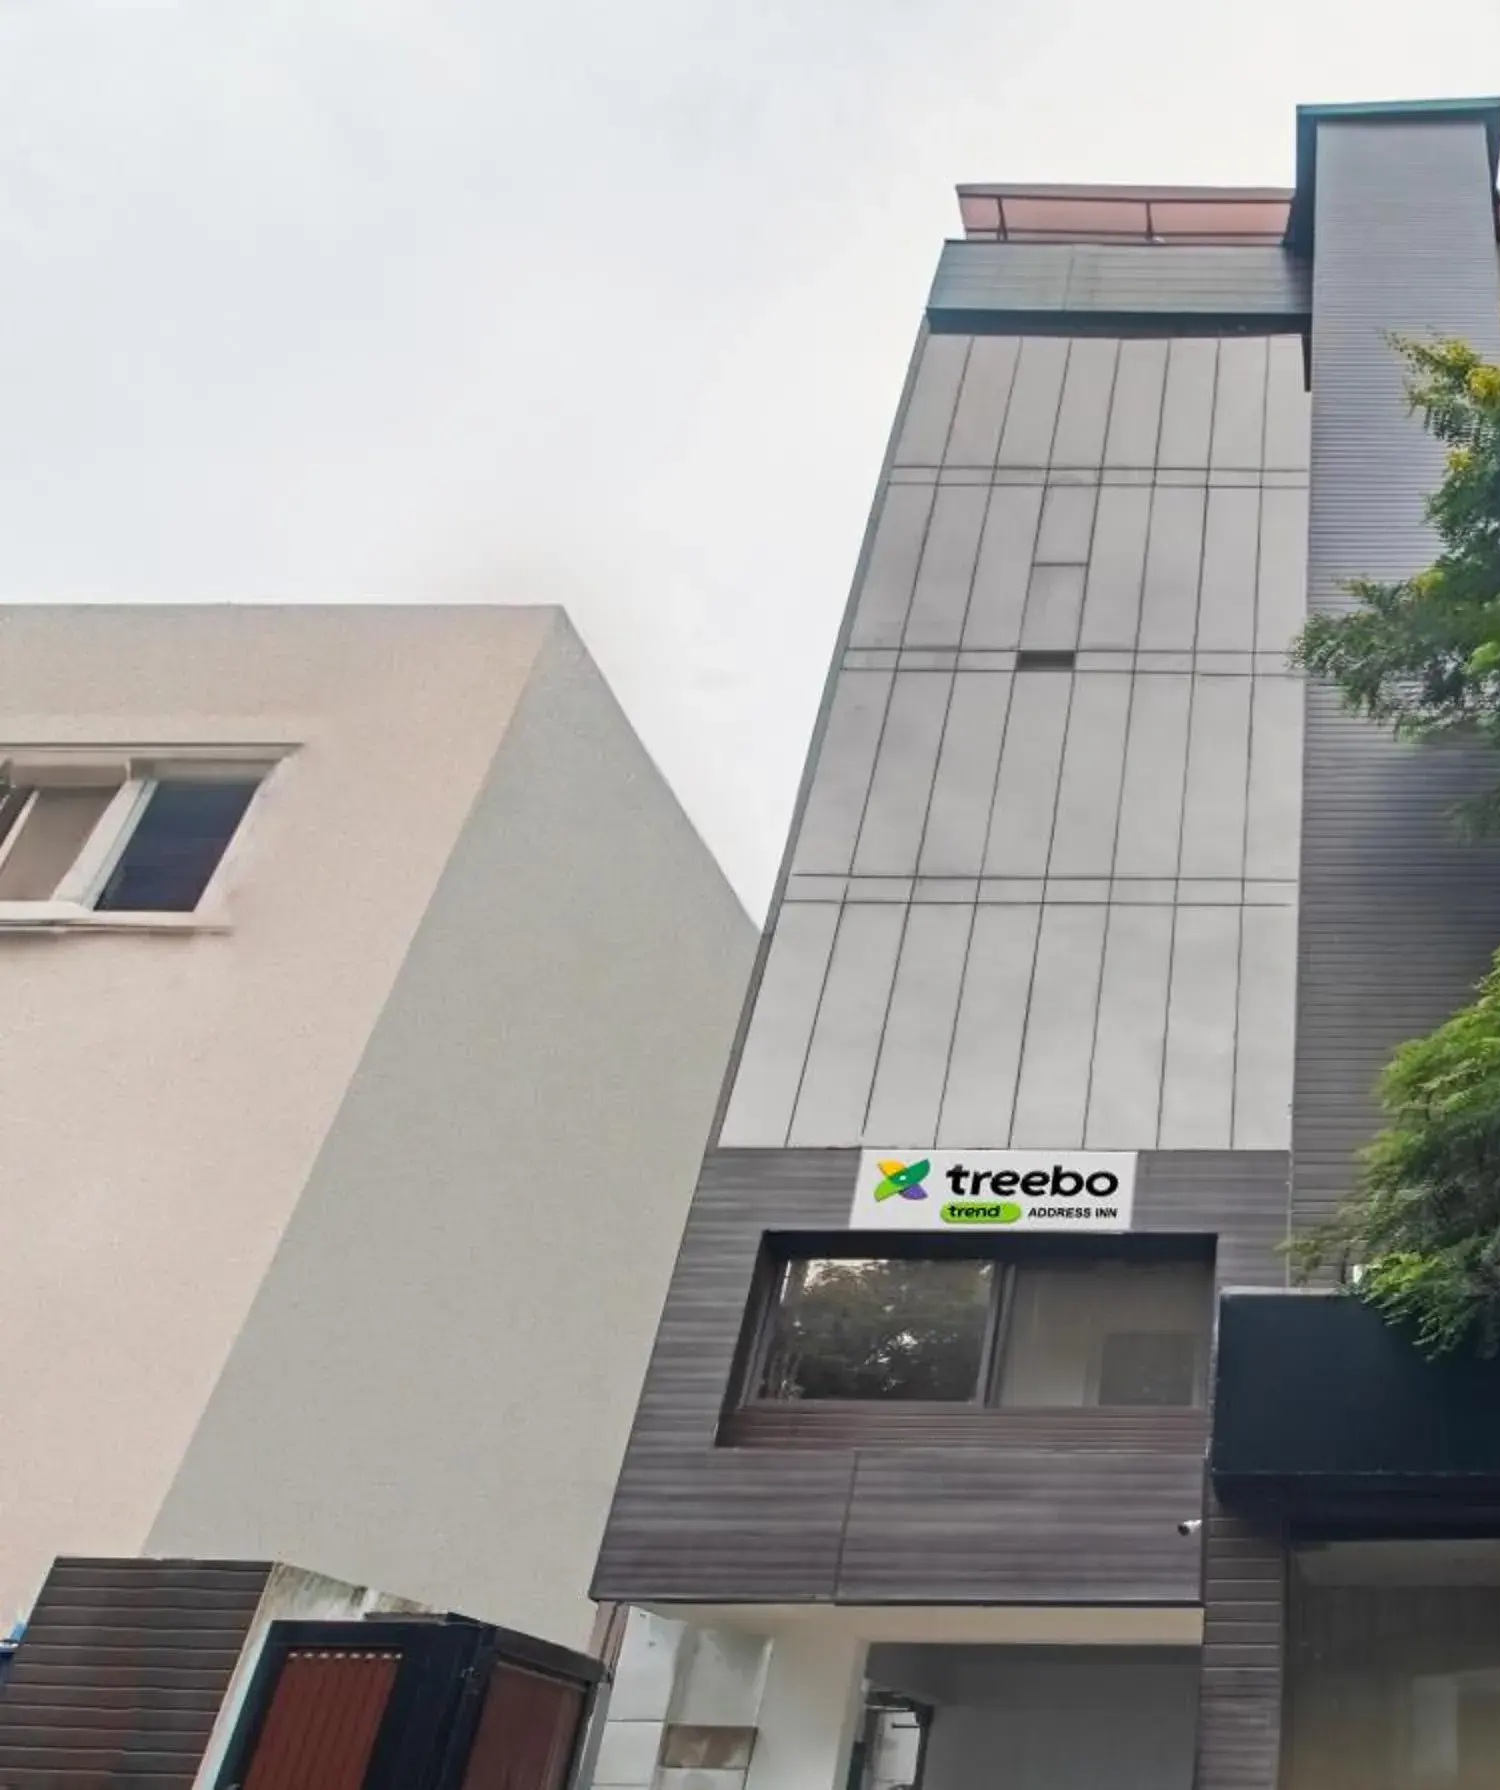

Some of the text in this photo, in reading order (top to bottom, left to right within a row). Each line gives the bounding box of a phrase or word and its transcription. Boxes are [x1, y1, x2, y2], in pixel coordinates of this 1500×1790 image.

[945, 1164, 1118, 1198] treebo
[948, 1204, 1001, 1219] trend
[1028, 1207, 1118, 1219] ADDRESS INN
